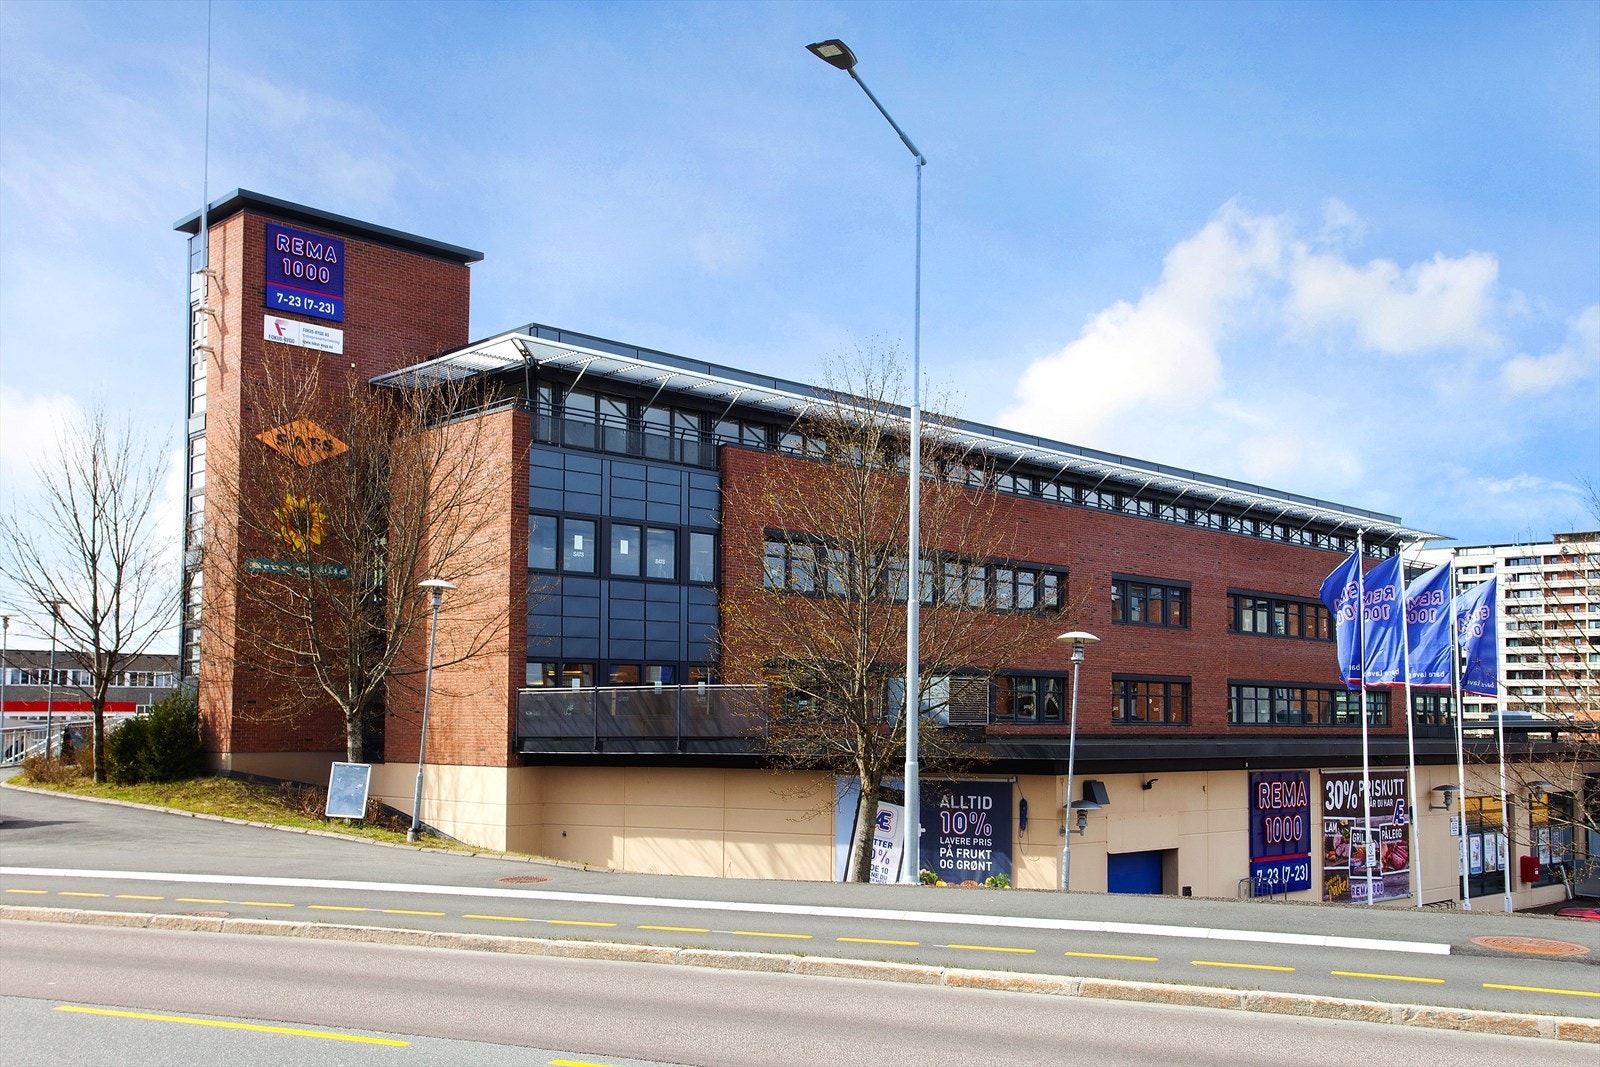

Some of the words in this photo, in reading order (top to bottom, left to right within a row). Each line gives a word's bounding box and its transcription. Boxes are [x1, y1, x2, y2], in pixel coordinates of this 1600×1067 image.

[276, 233, 337, 264] REMA
[283, 258, 330, 284] 1000
[276, 292, 302, 307] 7-23
[304, 298, 335, 315] (7-23)
[276, 433, 334, 451] SATS
[940, 794, 993, 810] ALLTID
[1258, 780, 1307, 809] REMA
[1325, 780, 1358, 811] 30%
[1369, 797, 1377, 808] ÅR
[1383, 799, 1394, 807] HAR
[1393, 798, 1405, 827] Æ
[940, 811, 993, 837] 10%
[1265, 815, 1303, 843] 1000
[1324, 821, 1338, 833] LAM
[1353, 832, 1366, 843] GRIL
[1382, 826, 1403, 840] PÅLEGG
[874, 839, 893, 849] TTER
[940, 836, 971, 846] LAVERE
[973, 838, 993, 847] PRIS
[940, 844, 954, 858] PÅ
[956, 848, 993, 860] FRUKT
[881, 867, 889, 875] 10
[940, 859, 954, 869] OG
[956, 860, 993, 872] GRØNT
[1256, 867, 1279, 887] 7-23
[1282, 862, 1308, 884] (7-23)
[1372, 881, 1385, 895] 000
